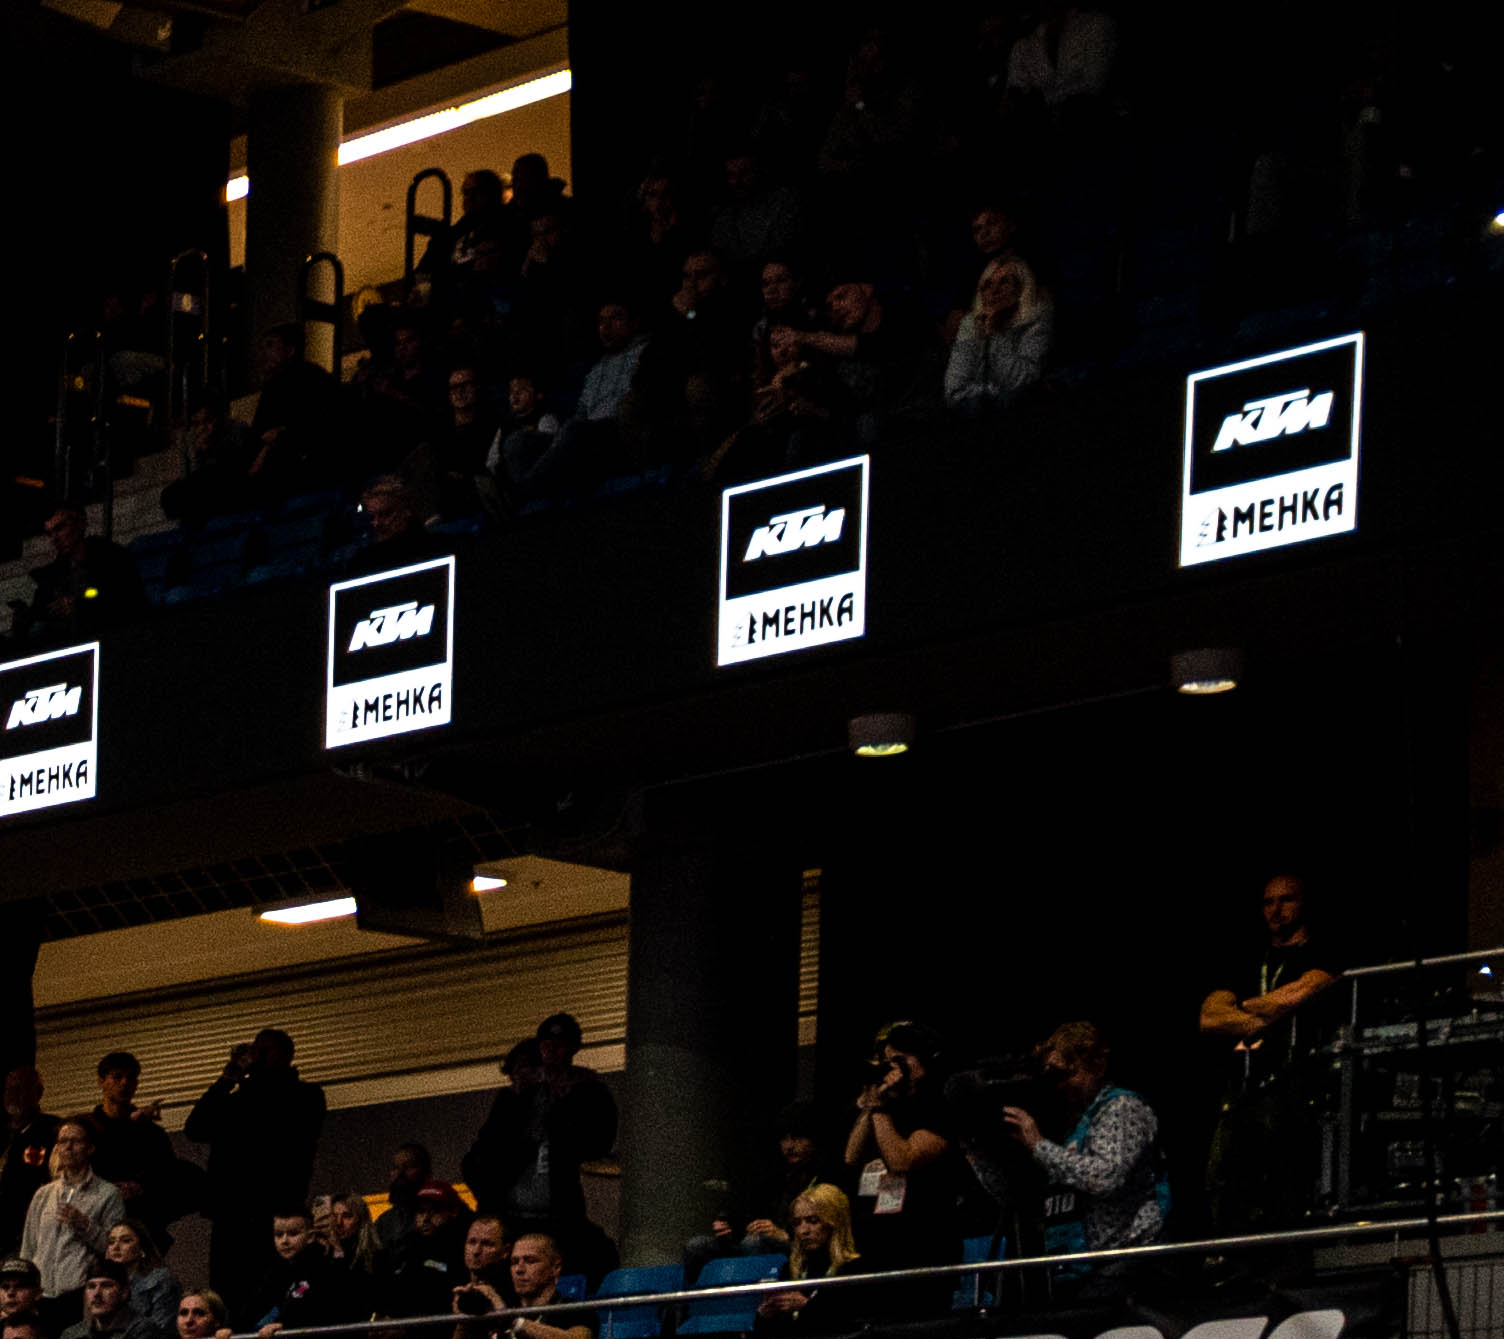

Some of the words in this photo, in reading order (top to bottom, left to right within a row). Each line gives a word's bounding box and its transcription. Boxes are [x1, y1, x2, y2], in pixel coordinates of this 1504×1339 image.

[1211, 388, 1335, 453] KTM
[743, 504, 846, 562] KTM
[1231, 483, 1344, 537] MEHKA
[348, 601, 436, 653] KTM
[760, 592, 855, 641] MEHKA
[6, 682, 82, 730] KTM
[363, 682, 443, 726] MEHKA
[19, 758, 88, 798] MEHKA
